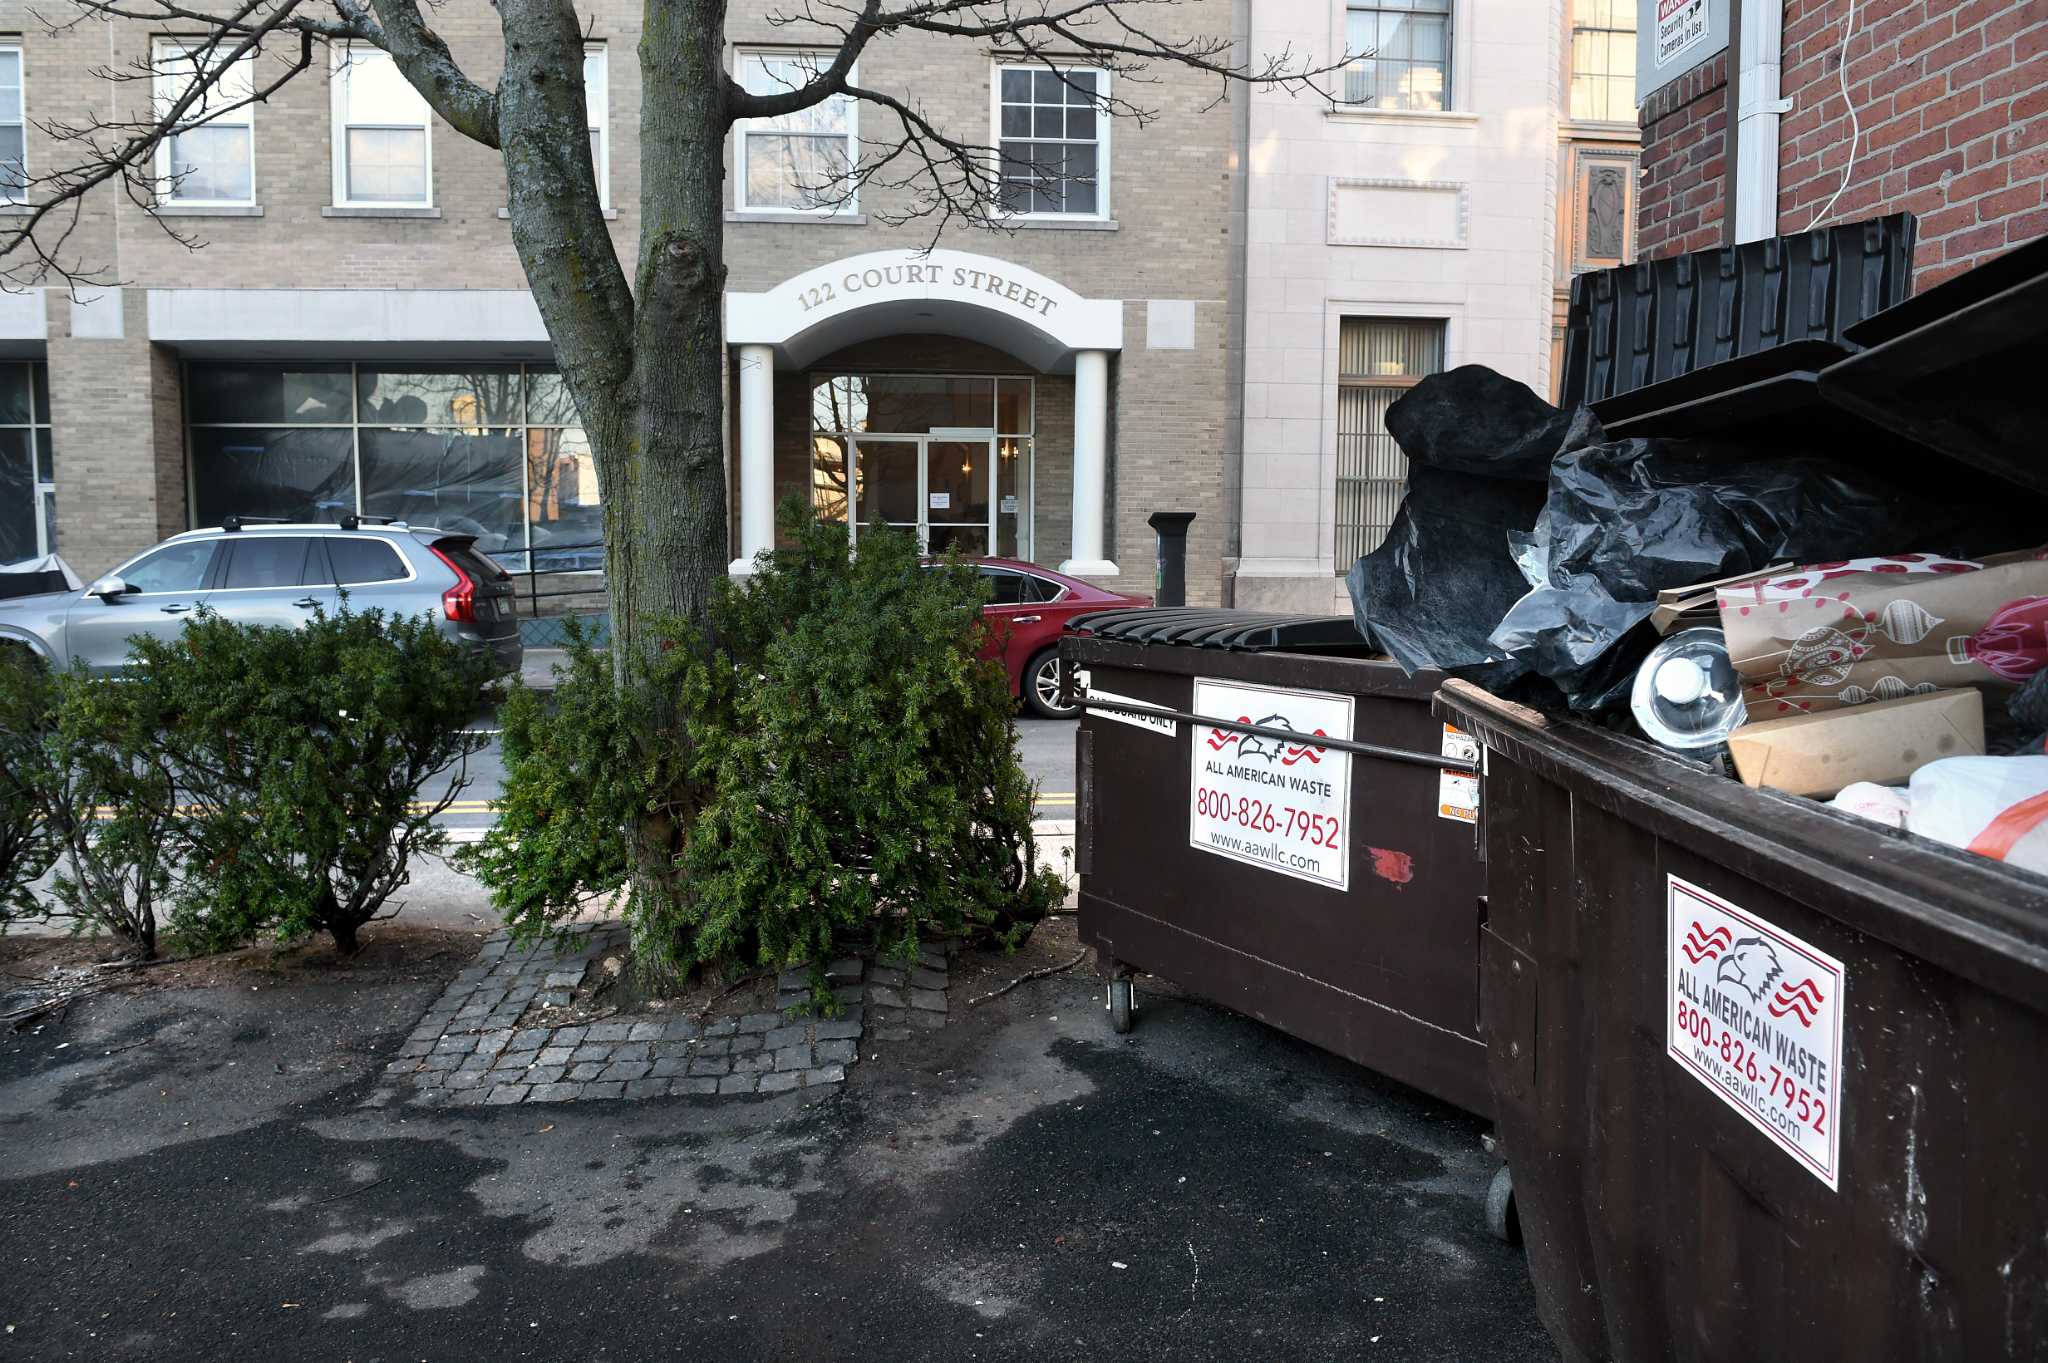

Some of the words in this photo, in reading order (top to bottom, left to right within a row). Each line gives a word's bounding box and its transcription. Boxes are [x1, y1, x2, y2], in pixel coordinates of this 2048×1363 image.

[1660, 14, 1684, 39] Security
[1660, 34, 1684, 58] Cameras
[1691, 21, 1702, 37] Use
[797, 282, 837, 312] 122
[843, 264, 944, 293] COURT
[952, 267, 1059, 317] STREET
[1149, 713, 1174, 731] ONLY
[1205, 759, 1223, 775] ALL
[1226, 764, 1286, 788] AMERICAN
[1289, 776, 1332, 798] WASTE
[1197, 787, 1339, 850] 800-826-7952
[1211, 831, 1320, 874] www.aawllc.com
[1678, 967, 1699, 1004] ALL
[1702, 984, 1772, 1054] AMERICAN
[1775, 1029, 1827, 1096] WASTE
[1677, 1000, 1826, 1136] 800-826-7952
[1693, 1044, 1801, 1142] www.aawllc.com
